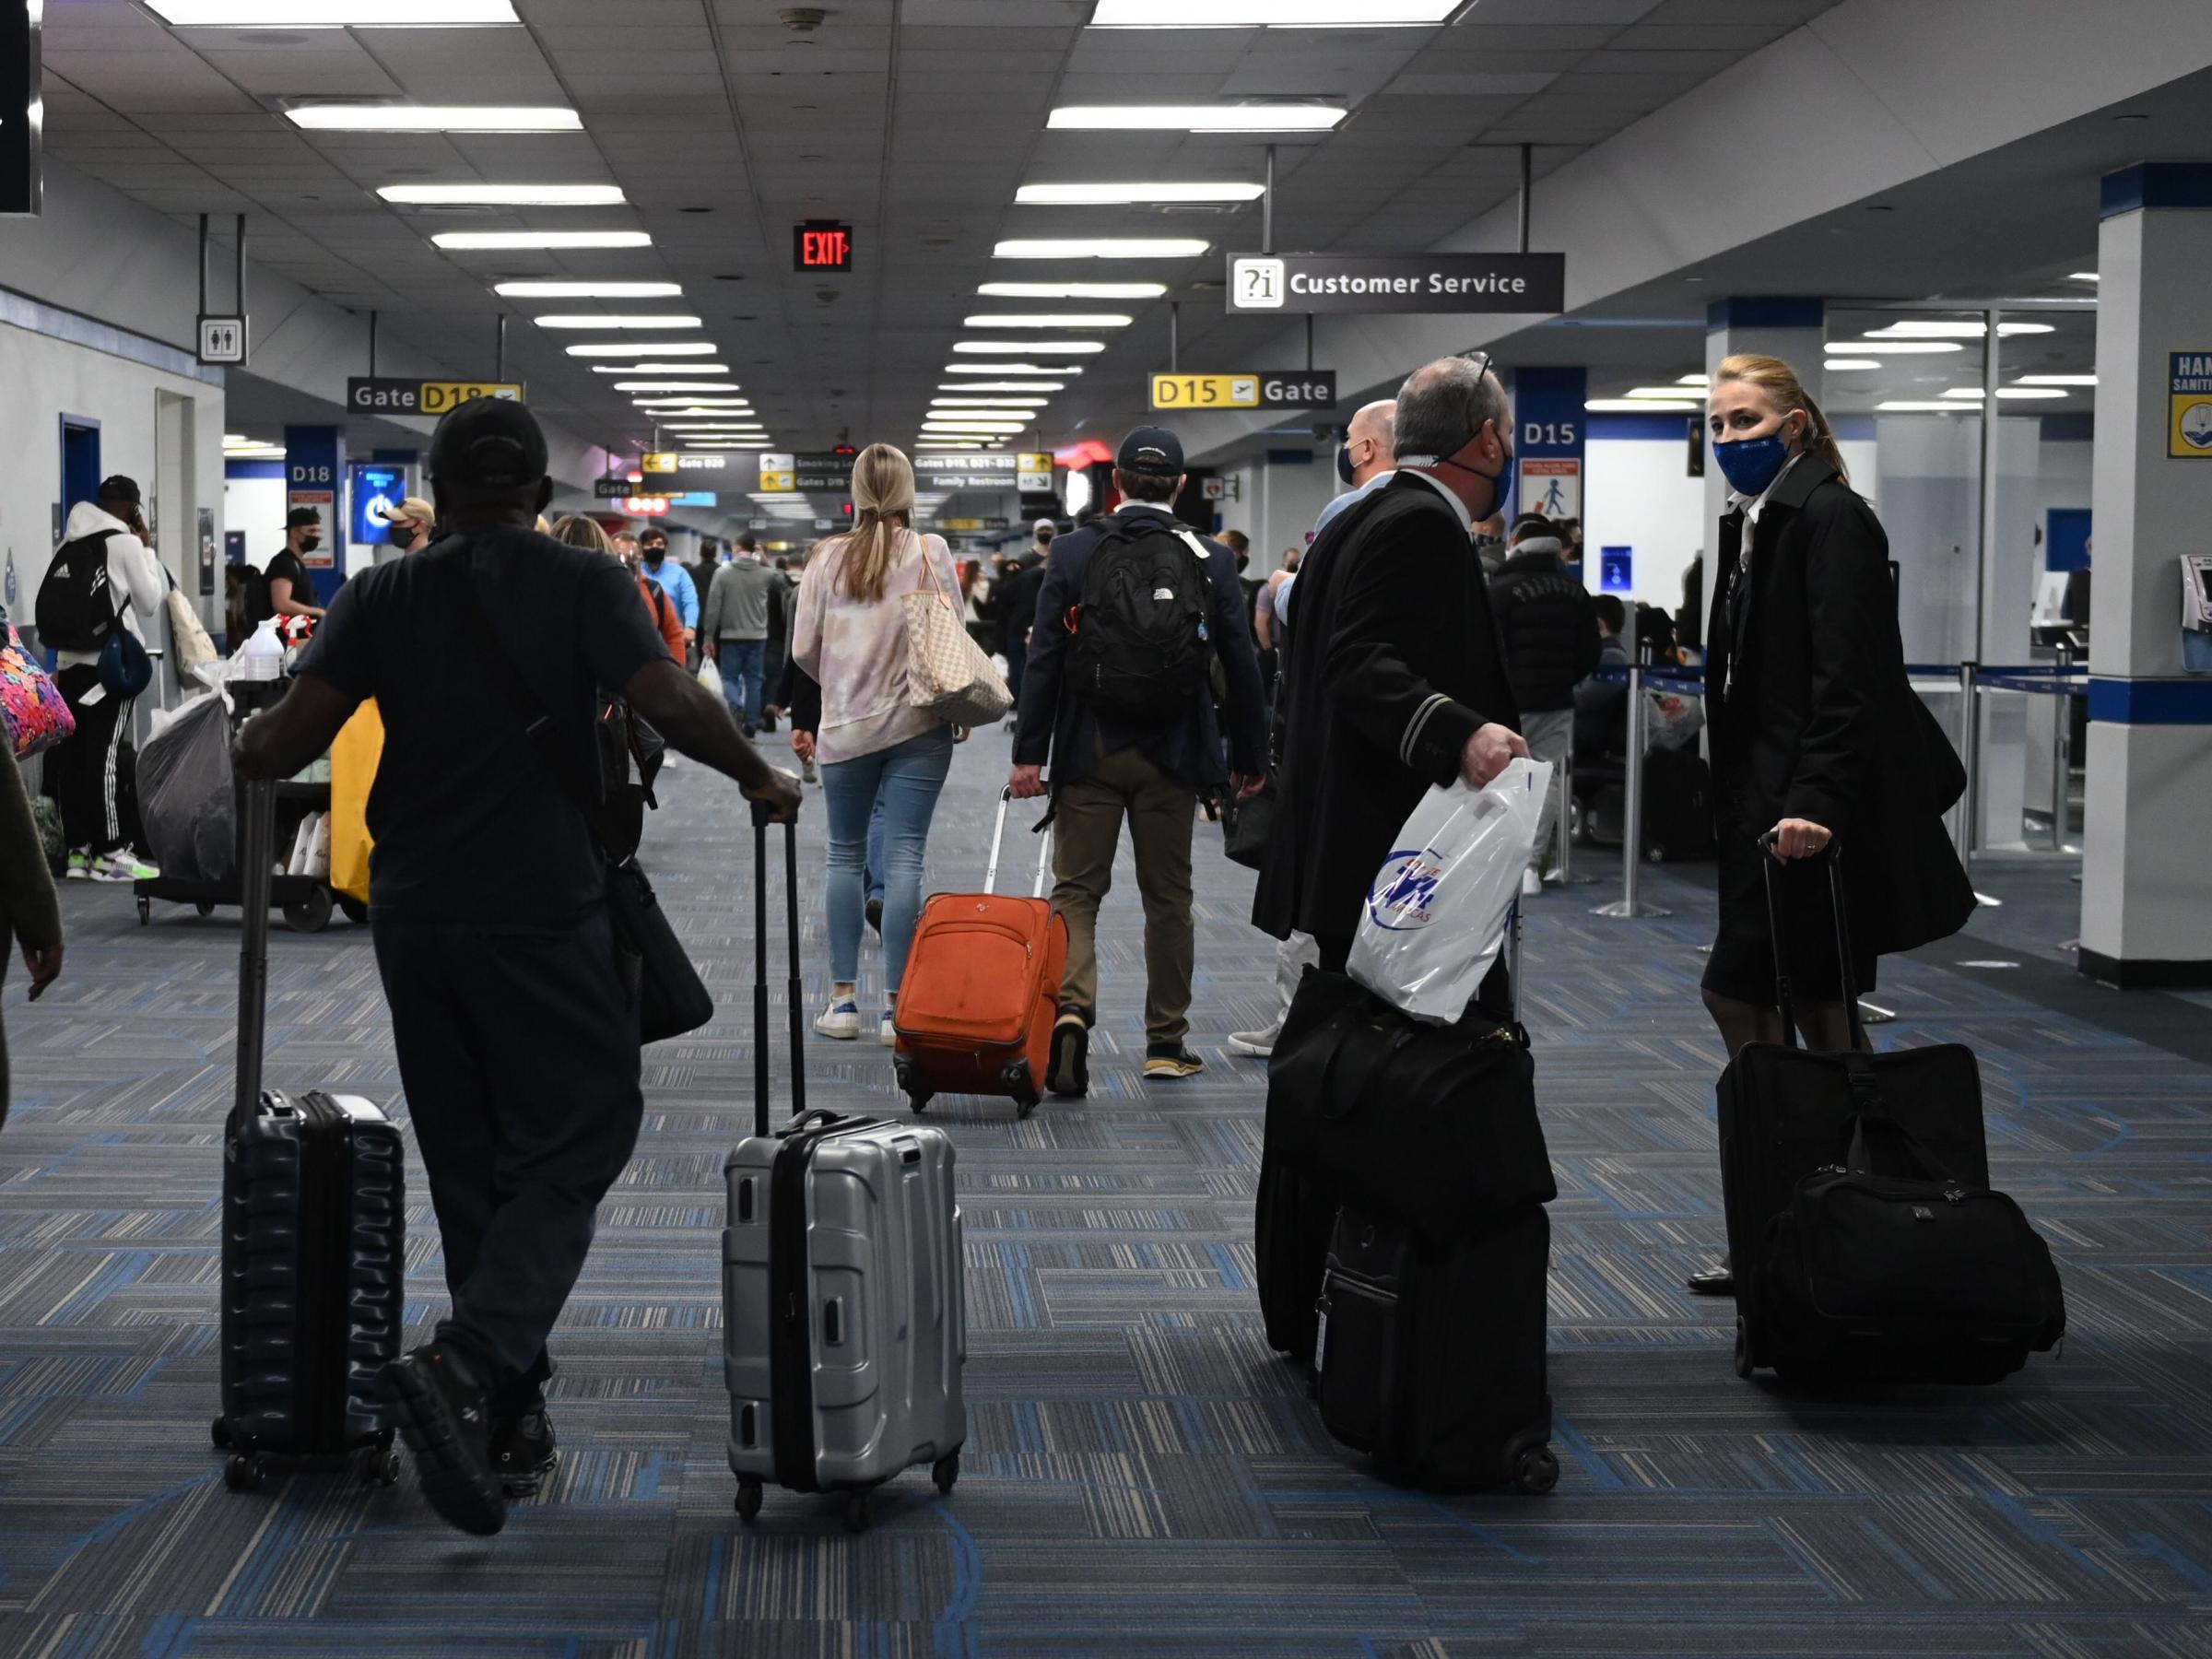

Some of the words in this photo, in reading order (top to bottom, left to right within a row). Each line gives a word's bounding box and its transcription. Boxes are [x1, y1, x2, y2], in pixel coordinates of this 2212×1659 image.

[804, 232, 845, 265] EXIT
[1290, 274, 1420, 294] Customer
[1429, 273, 1526, 294] Service
[355, 386, 415, 406] Gate
[1159, 379, 1218, 404] D15
[1265, 381, 1328, 401] Gate
[1524, 423, 1575, 444] D15
[796, 459, 840, 469] Smoking
[915, 458, 944, 468] Gates
[293, 466, 330, 482] D18
[933, 477, 965, 487] Family
[969, 477, 1016, 486] Restroom
[599, 484, 630, 495] Gate
